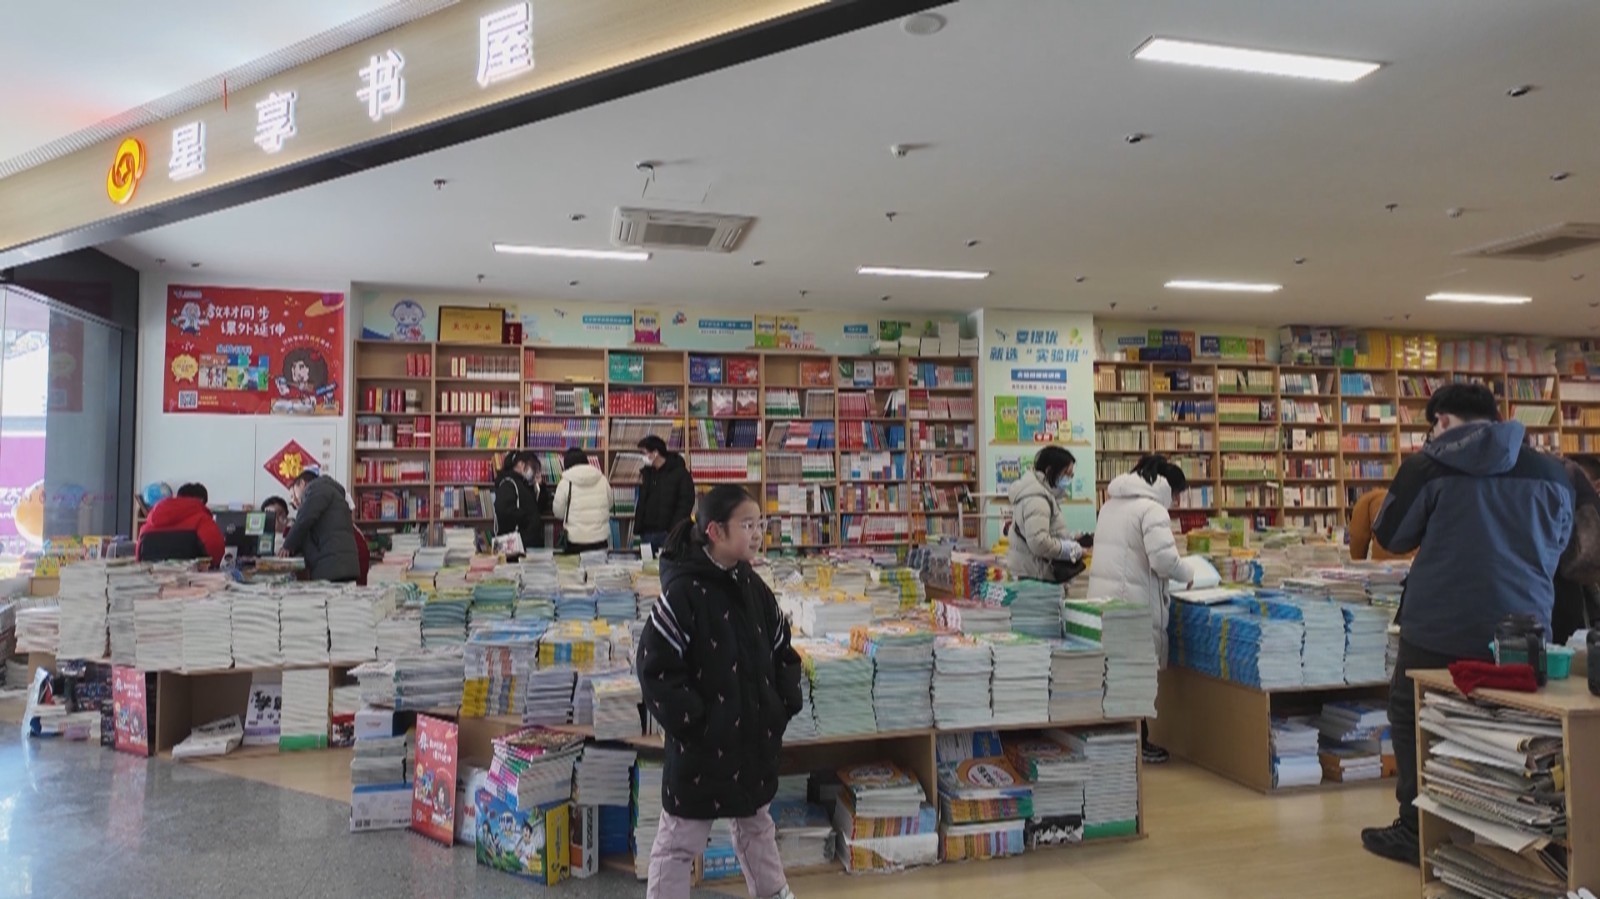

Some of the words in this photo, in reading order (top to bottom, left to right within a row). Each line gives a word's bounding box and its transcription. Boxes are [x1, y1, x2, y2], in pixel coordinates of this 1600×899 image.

[206, 303, 270, 321] 教材同步
[220, 320, 286, 338] 课外延伸
[1015, 329, 1059, 346] 要提优
